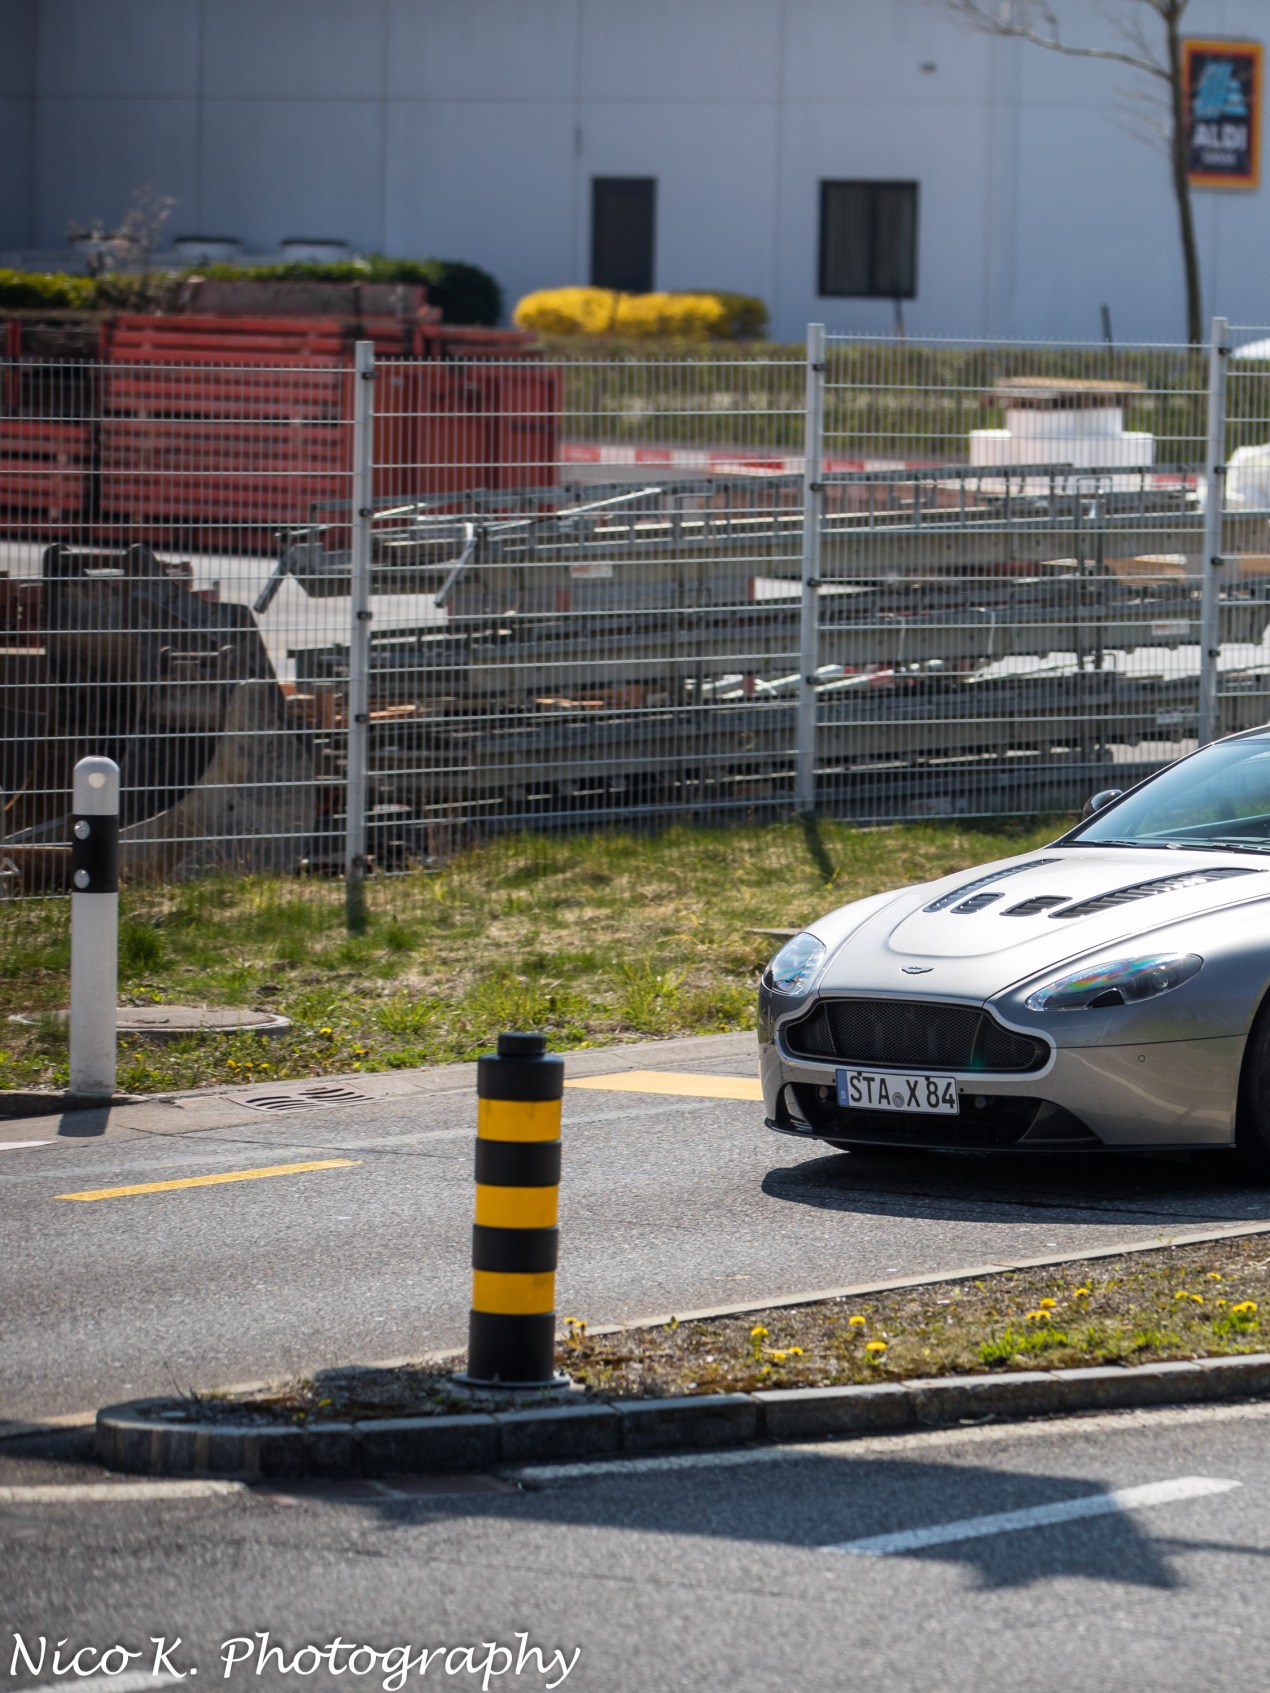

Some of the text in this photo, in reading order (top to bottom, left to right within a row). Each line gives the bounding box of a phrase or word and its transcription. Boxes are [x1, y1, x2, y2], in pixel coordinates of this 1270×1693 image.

[1192, 122, 1248, 151] ALDI
[850, 1075, 891, 1105] STA
[906, 1079, 921, 1107] X
[926, 1081, 956, 1108] 84
